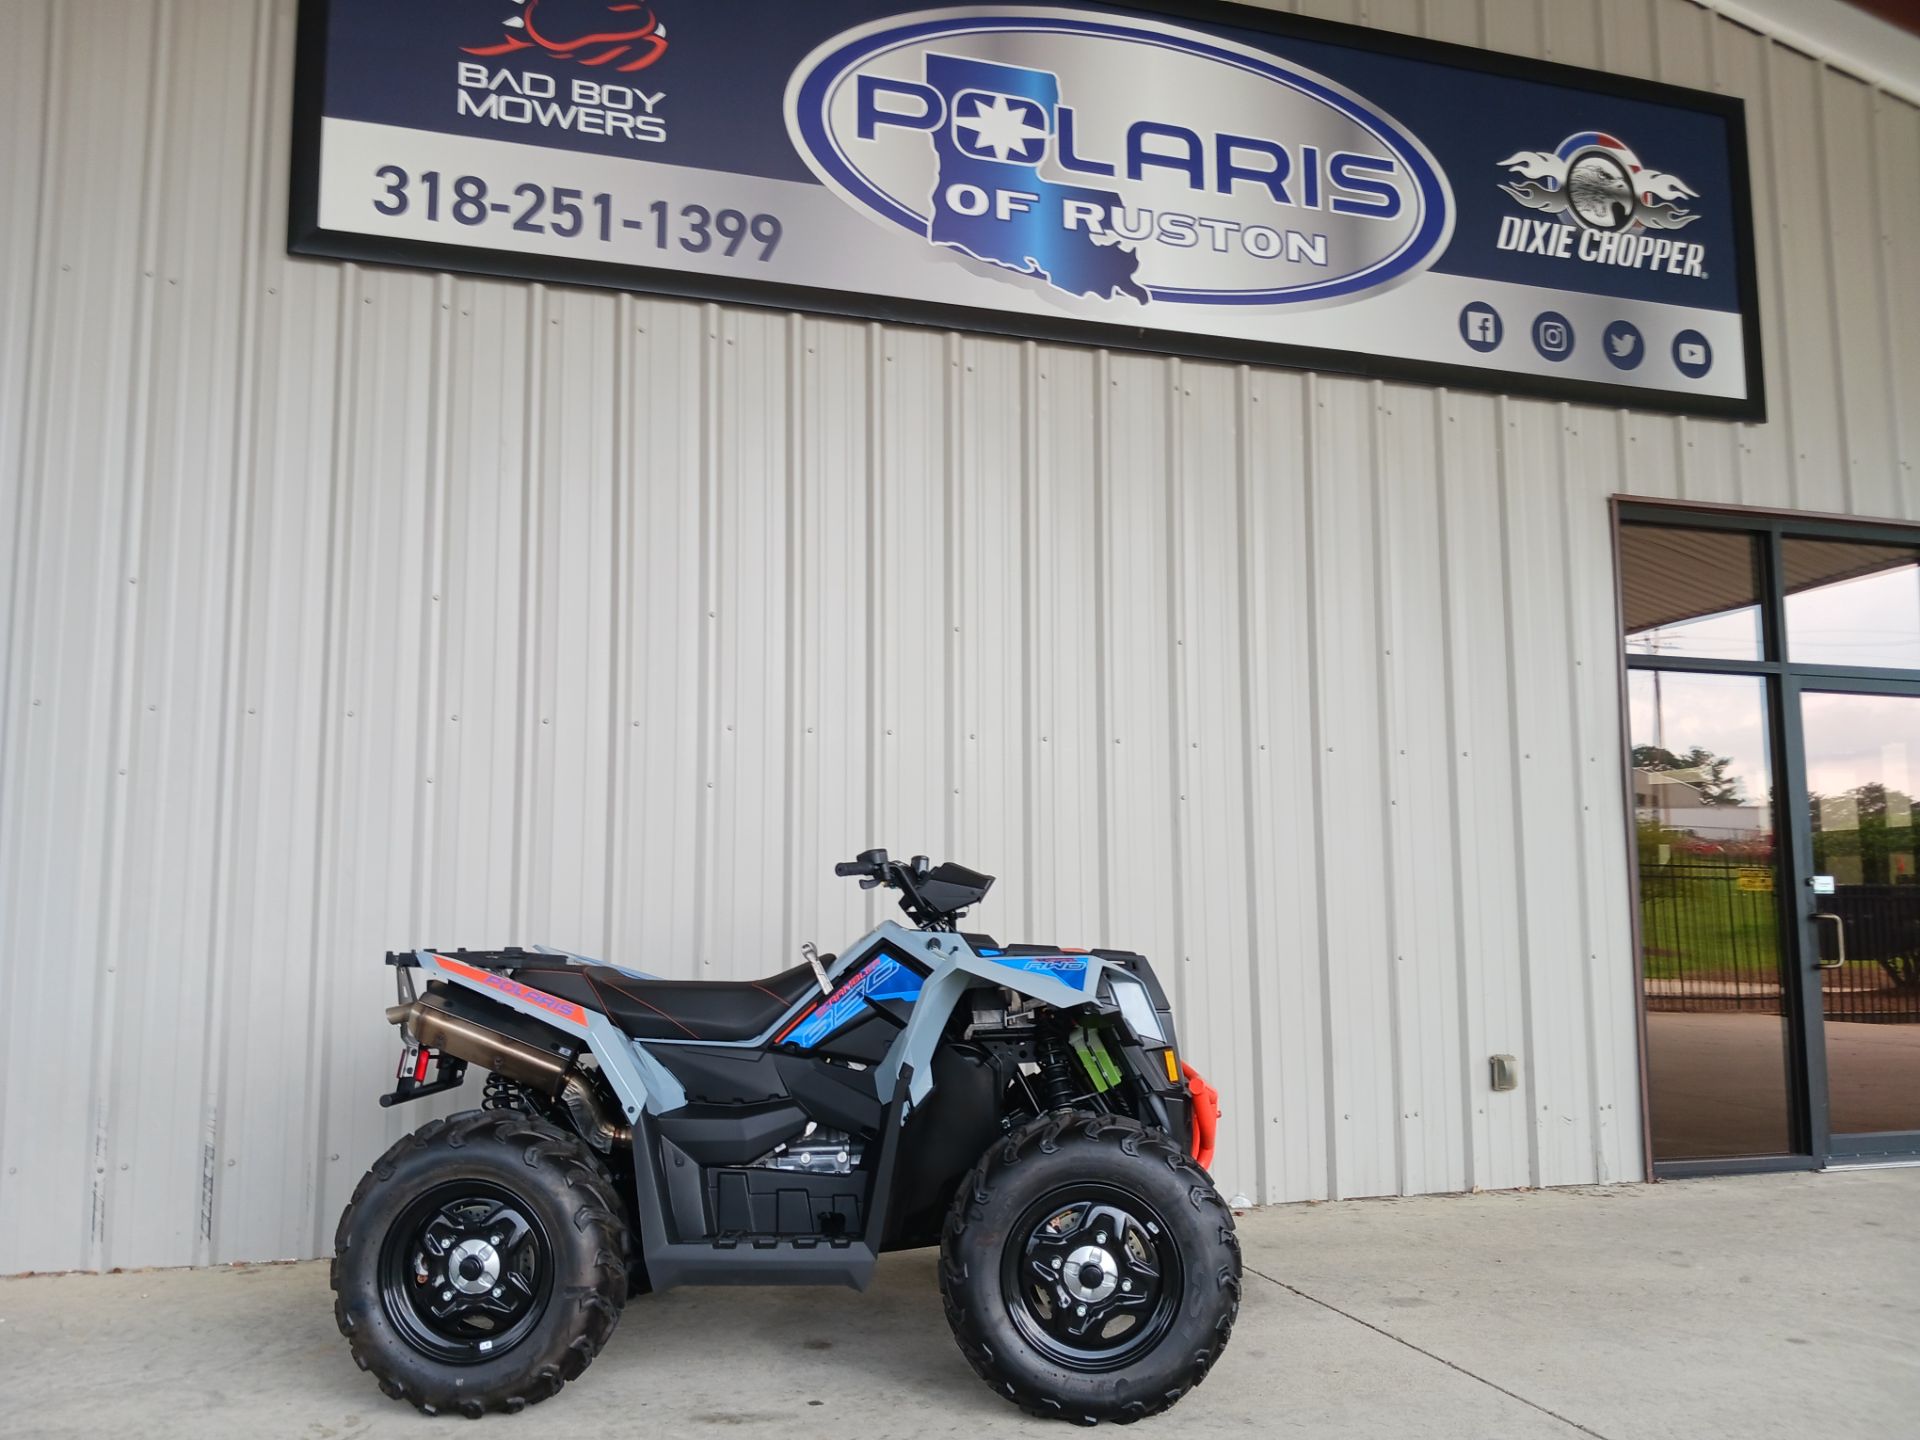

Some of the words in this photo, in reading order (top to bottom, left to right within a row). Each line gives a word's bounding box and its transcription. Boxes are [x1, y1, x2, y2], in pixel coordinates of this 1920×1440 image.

[456, 88, 667, 144] MOWERS
[457, 61, 556, 99] BAD
[571, 79, 667, 114] BOY
[855, 74, 1402, 220] POLARIS
[372, 164, 783, 263] 318-251-1399
[944, 182, 1040, 221] OF
[1062, 198, 1328, 267] RUSTON
[1496, 215, 1577, 259] DIXIE
[484, 974, 576, 1016] POLARIS
[814, 957, 882, 1019] SCRAMBLER
